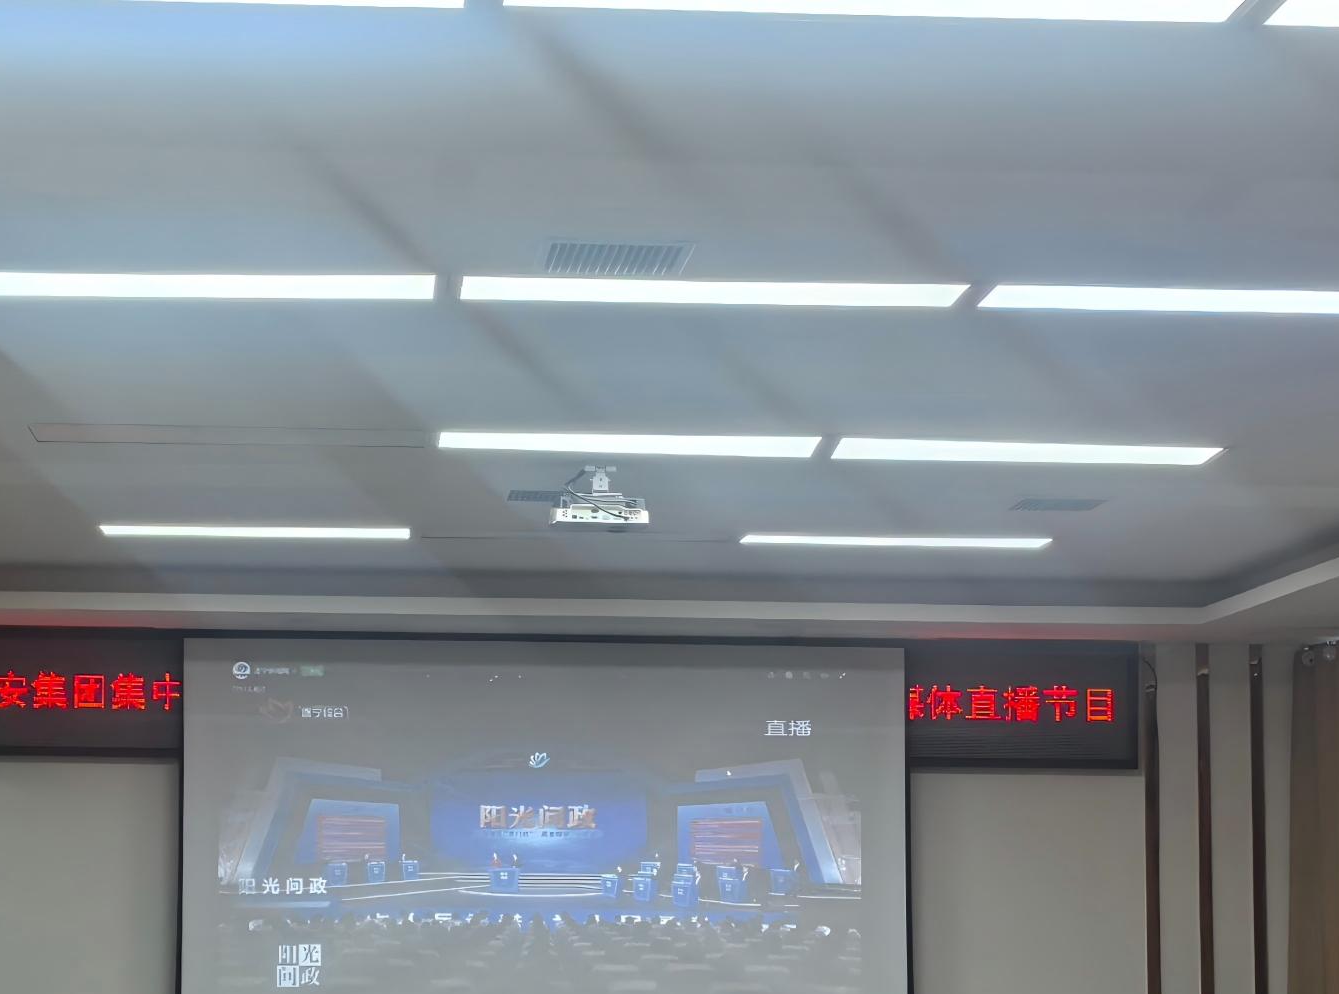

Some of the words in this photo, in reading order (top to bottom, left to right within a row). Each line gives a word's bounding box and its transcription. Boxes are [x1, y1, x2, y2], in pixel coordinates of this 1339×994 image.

[764, 720, 812, 737] 直播
[479, 804, 598, 829] 阳光问政
[238, 877, 327, 895] 阳光问政
